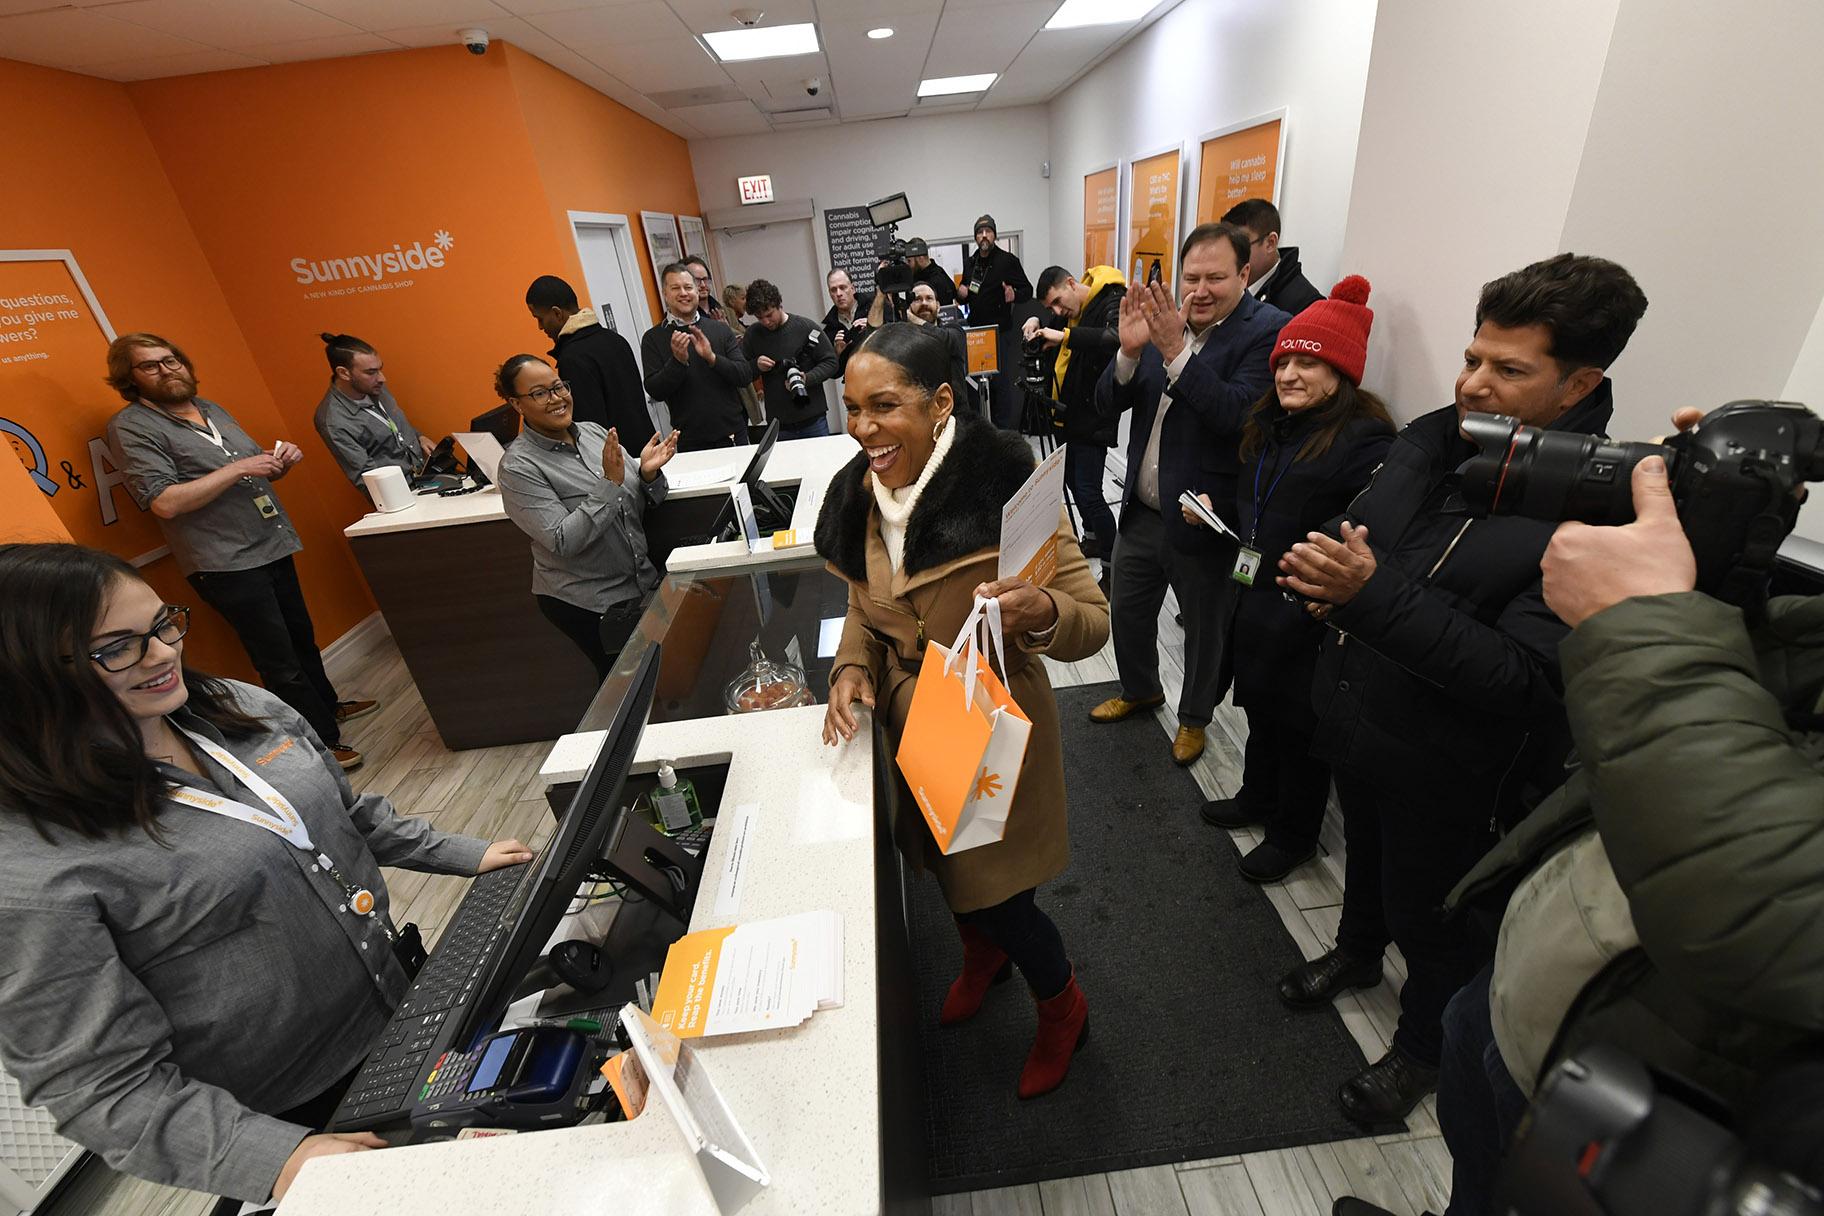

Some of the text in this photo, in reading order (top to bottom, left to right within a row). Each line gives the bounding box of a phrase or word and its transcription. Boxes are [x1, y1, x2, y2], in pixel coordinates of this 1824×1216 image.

[1241, 154, 1266, 168] cannabis
[742, 179, 768, 200] EXIT
[828, 212, 860, 221] Cannabis
[830, 228, 852, 237] impair
[831, 236, 844, 244] and
[862, 241, 874, 249] use
[850, 250, 865, 258] may
[834, 258, 852, 267] habit
[849, 263, 871, 272] should
[859, 271, 875, 279] used
[310, 290, 327, 300] NEW
[327, 288, 345, 298] KIND
[346, 286, 357, 295] OF
[357, 282, 394, 293] CANNABIS
[394, 279, 414, 289] SHOP
[0, 292, 74, 310] questions,
[0, 309, 80, 328] ou give me
[1281, 339, 1322, 352] POLITICO
[1, 356, 12, 364] us
[60, 460, 88, 490] &
[677, 1005, 691, 1030] Keep
[685, 984, 695, 1007] your
[688, 1004, 700, 1029] Reap
[695, 986, 704, 1003] the
